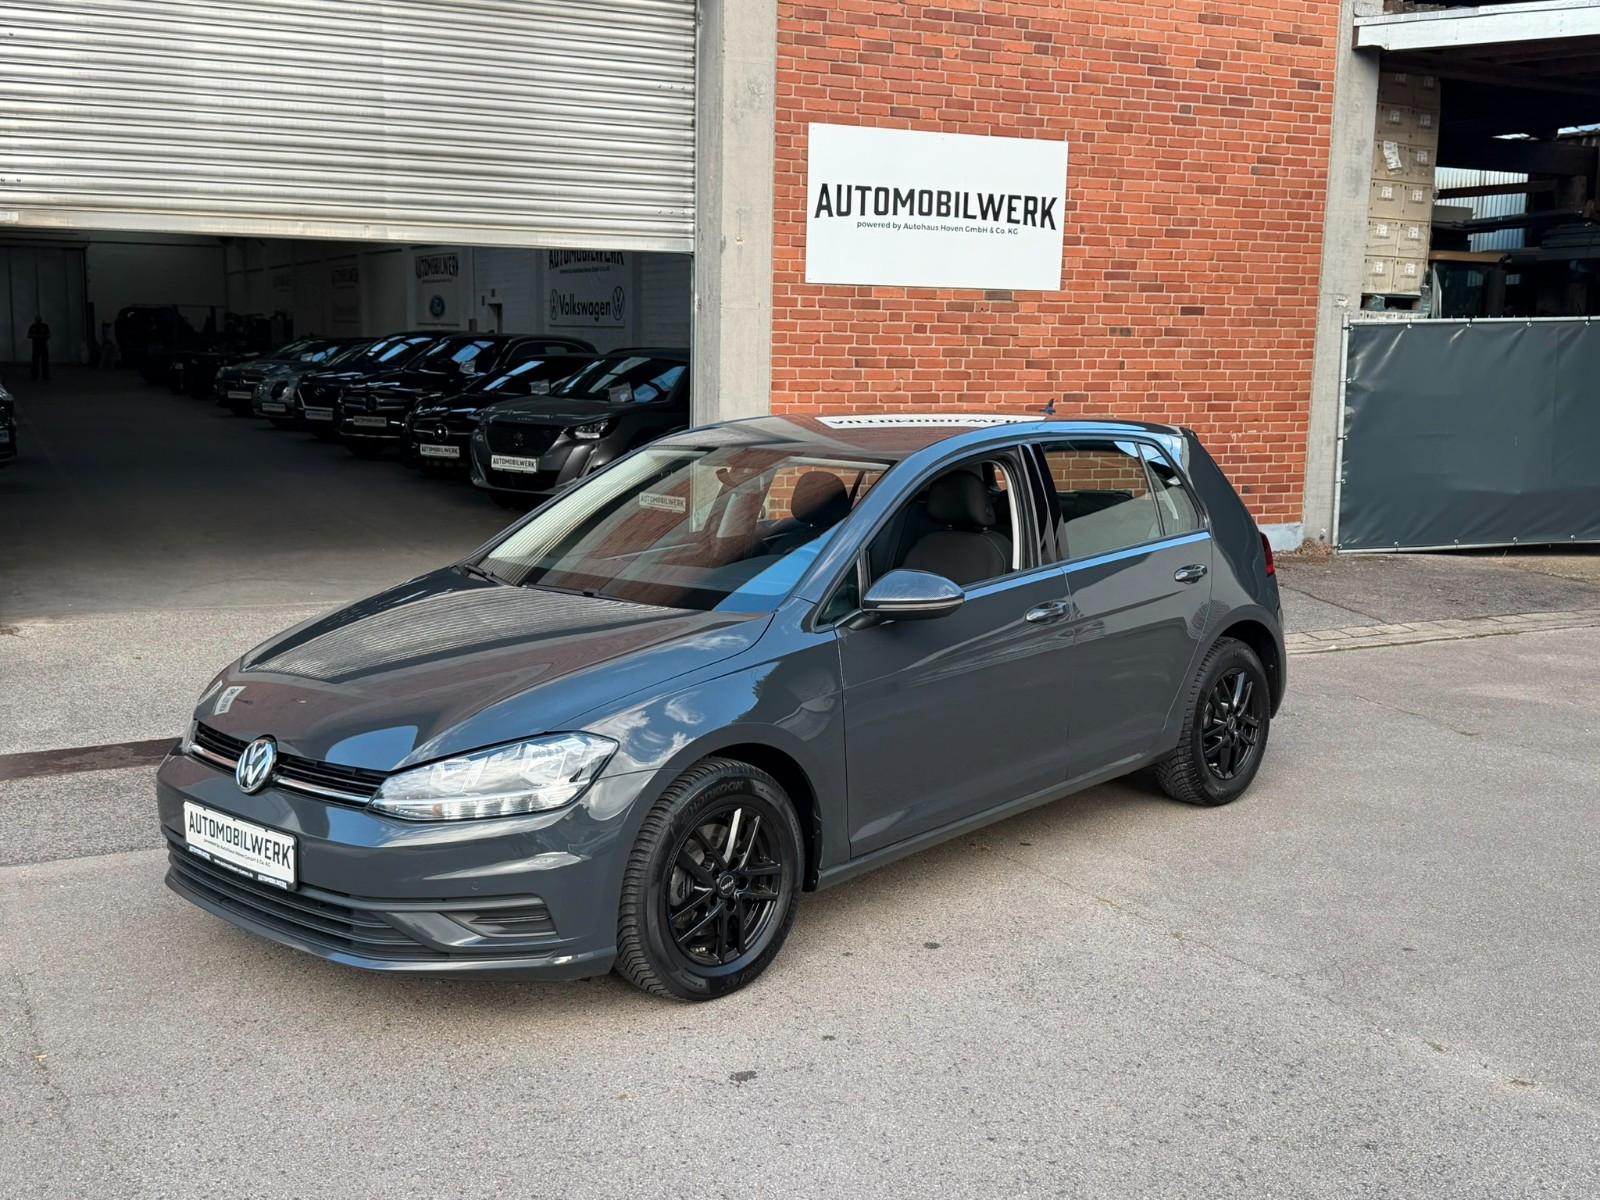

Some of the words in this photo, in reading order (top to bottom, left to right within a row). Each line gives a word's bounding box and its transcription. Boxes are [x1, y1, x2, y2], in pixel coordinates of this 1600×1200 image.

[814, 183, 1058, 231] AUTOMOBILWERK
[856, 221, 891, 229] powered
[892, 221, 902, 230] by
[903, 222, 939, 231] Autohaus
[940, 224, 964, 233] Hoven
[965, 225, 988, 234] GmbH
[989, 226, 994, 234] &
[559, 293, 611, 321] Volkswagen
[493, 456, 536, 468] AUTOMOBILWERK
[189, 811, 291, 869] AUTOMOBILWERK
